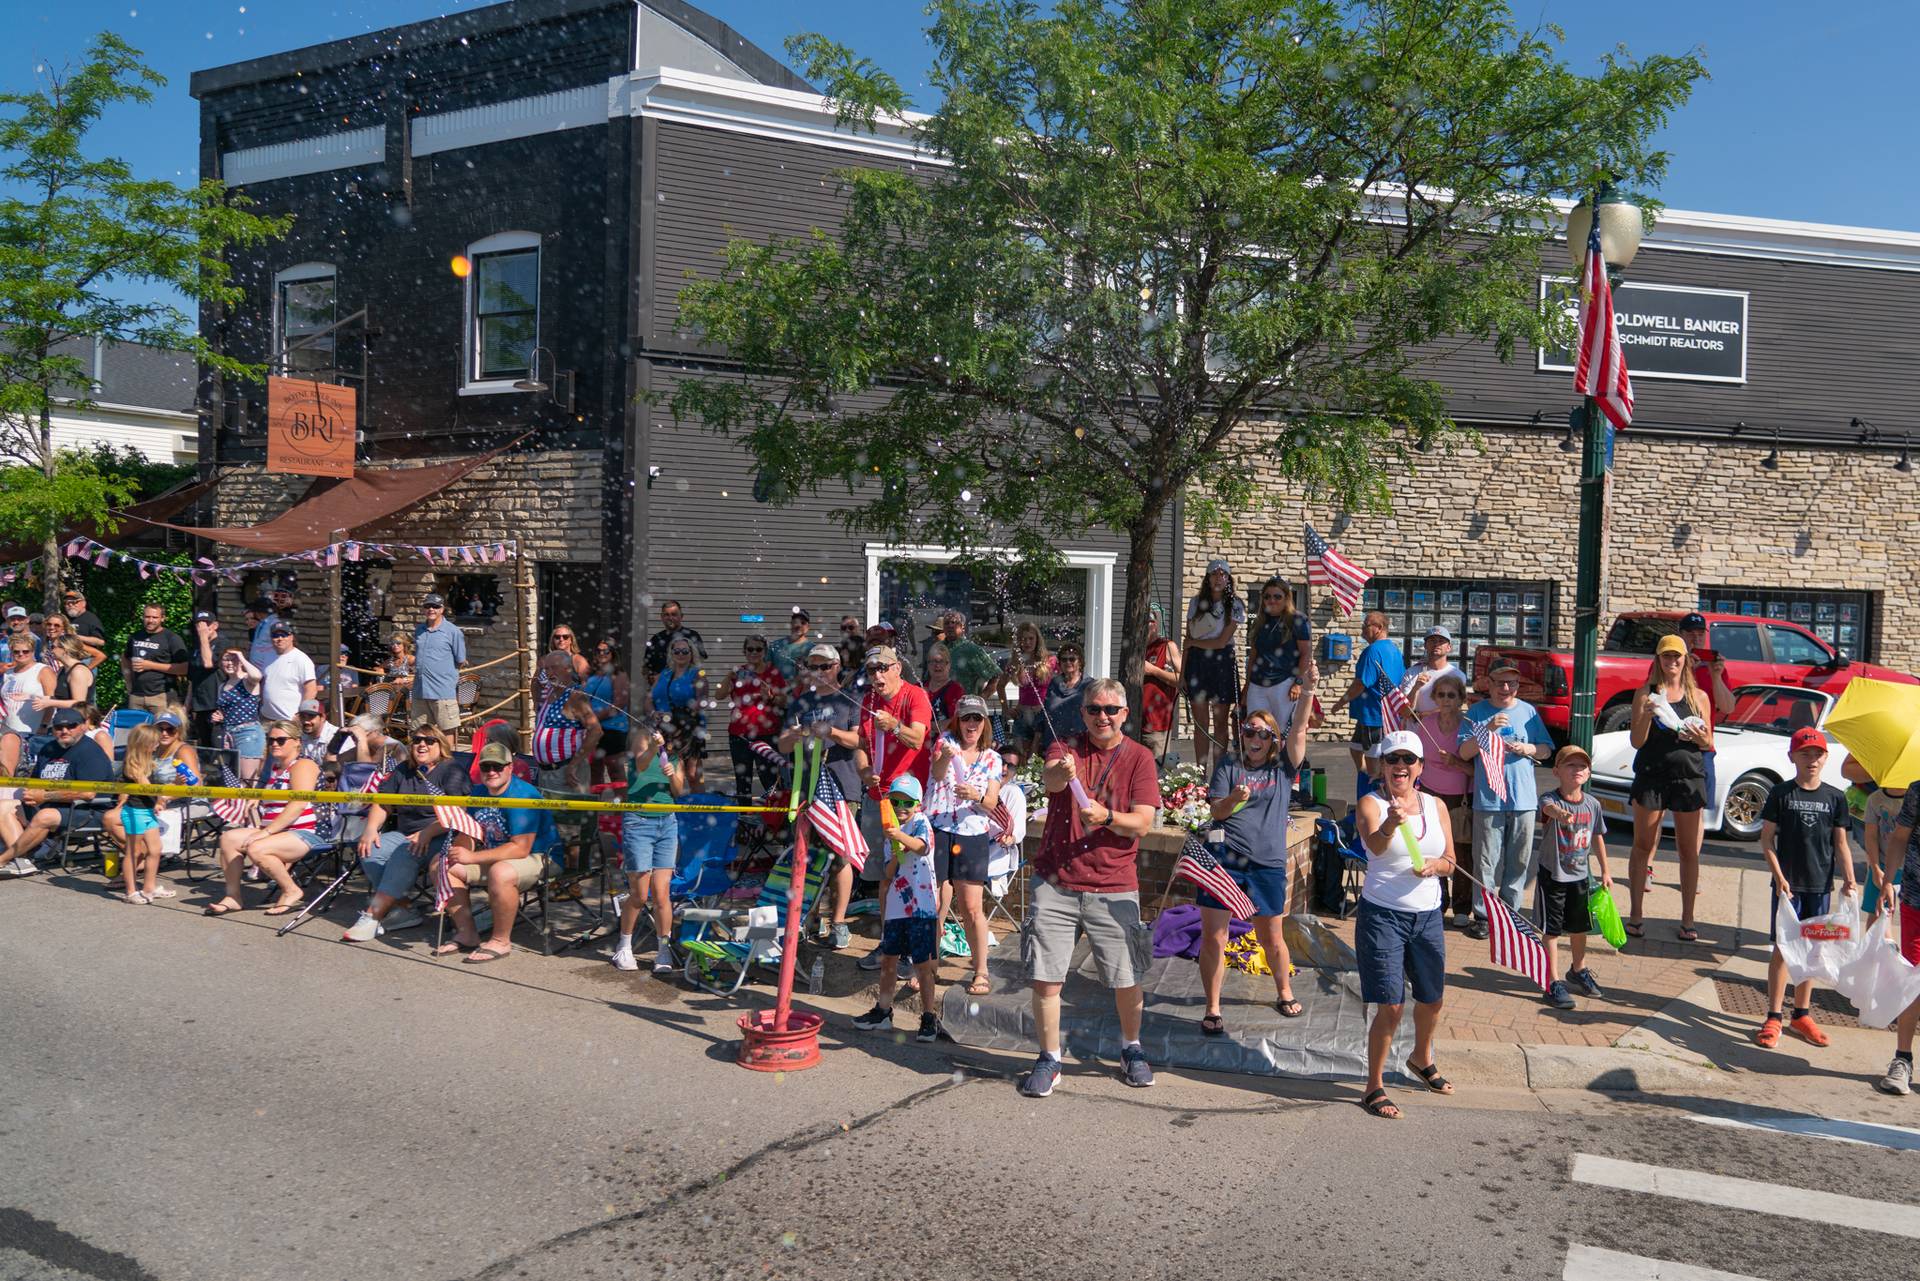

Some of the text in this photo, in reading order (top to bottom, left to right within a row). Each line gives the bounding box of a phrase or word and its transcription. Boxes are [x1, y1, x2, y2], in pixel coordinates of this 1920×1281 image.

[1614, 313, 1740, 335] OLDWELL BANKER
[1620, 334, 1724, 351] SCHMIDT REALTORS
[291, 412, 334, 443] BRI
[1788, 800, 1830, 812] BASEBALL
